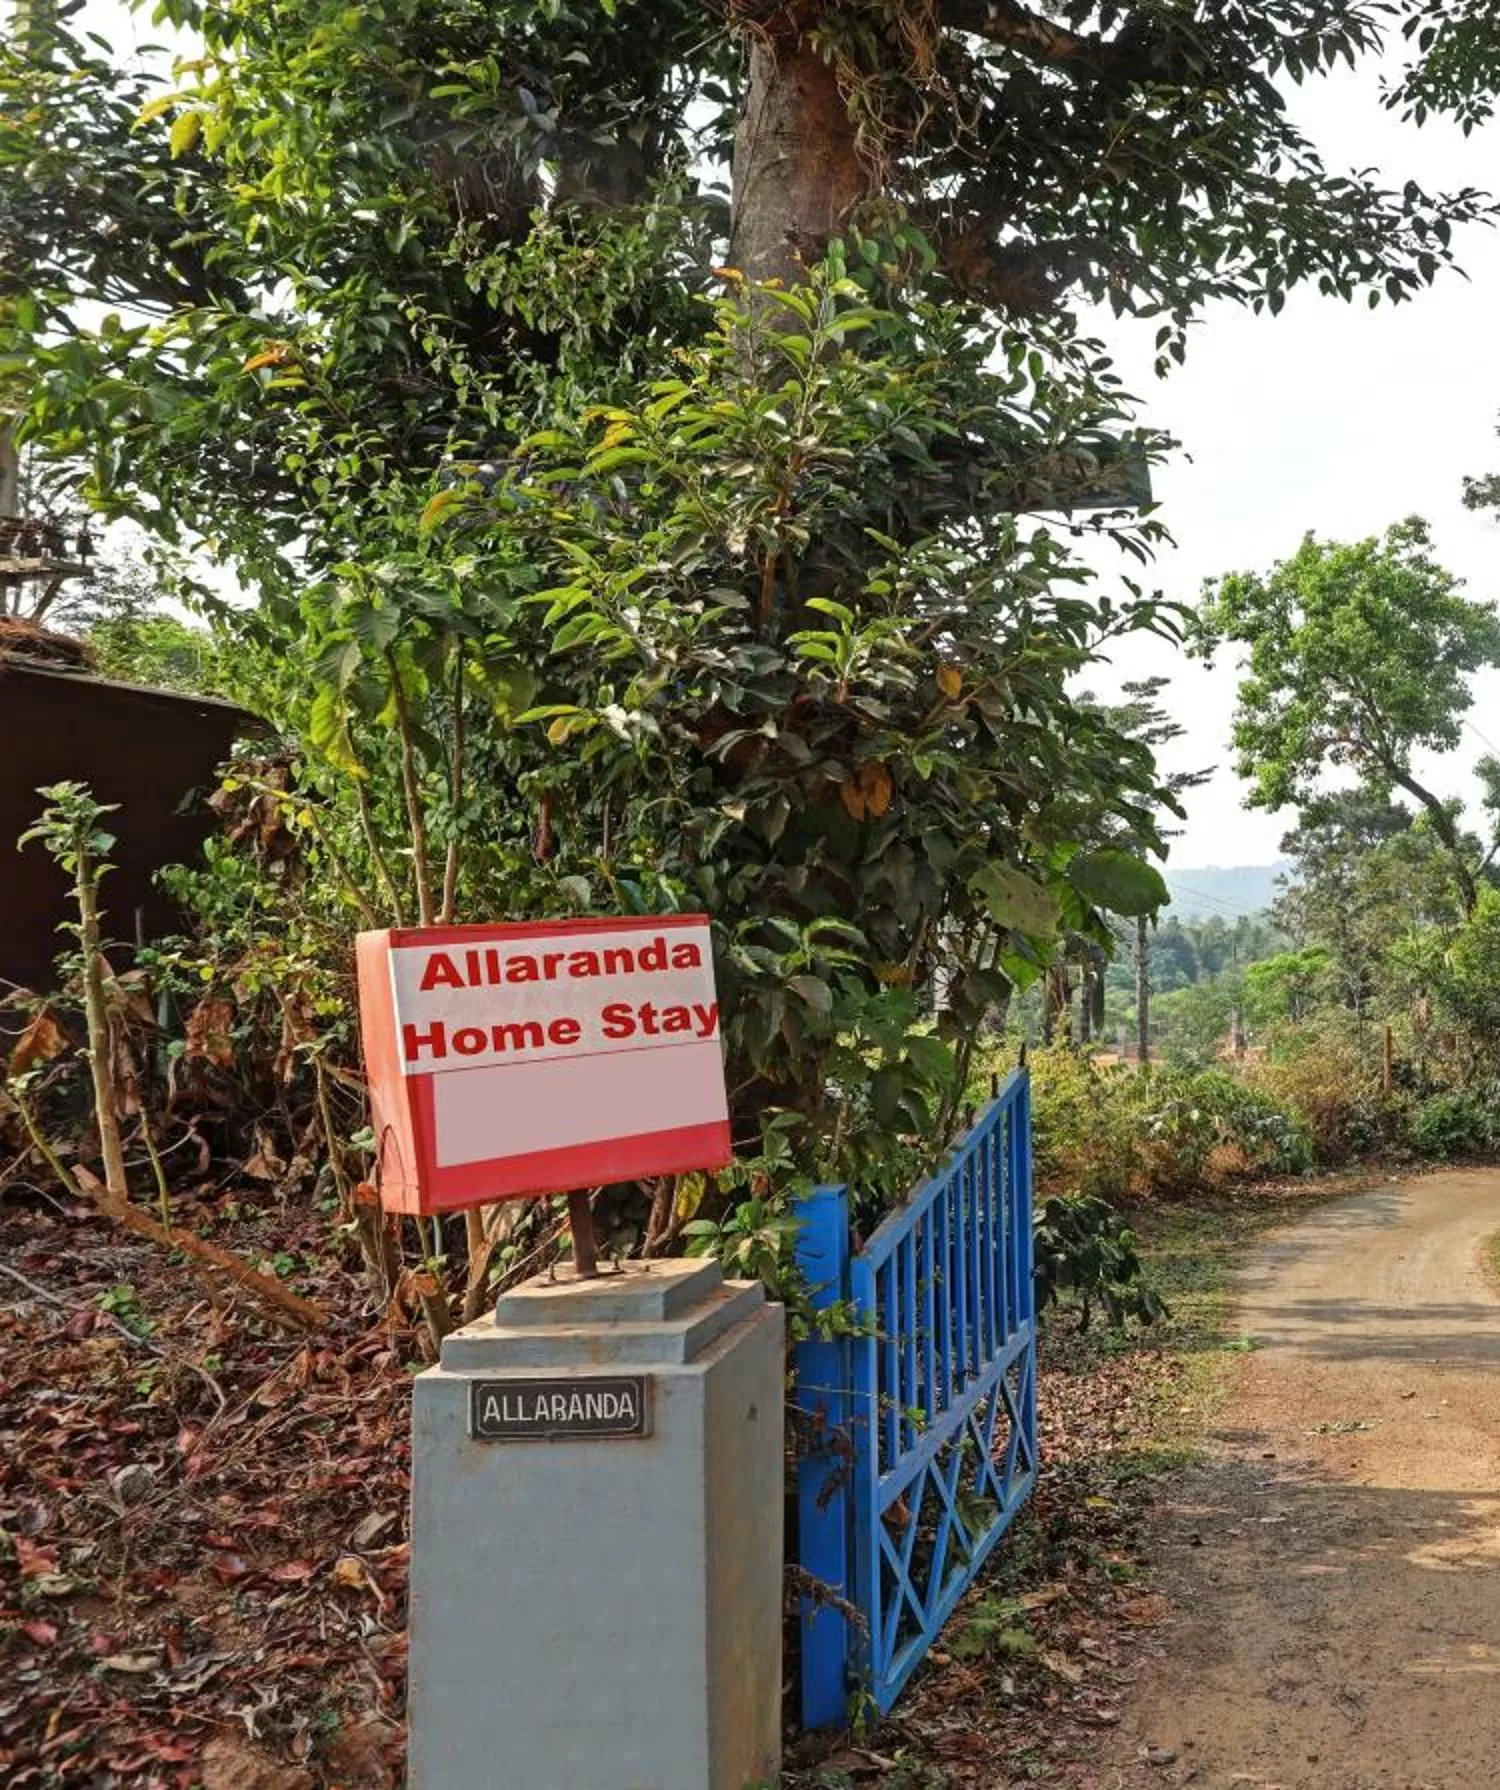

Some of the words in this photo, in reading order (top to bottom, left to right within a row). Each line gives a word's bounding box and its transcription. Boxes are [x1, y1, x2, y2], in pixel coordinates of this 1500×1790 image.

[419, 937, 702, 991] Allaranda
[402, 1017, 581, 1061] Home
[601, 1000, 719, 1039] Stay
[483, 1391, 635, 1423] ALLARANDA
